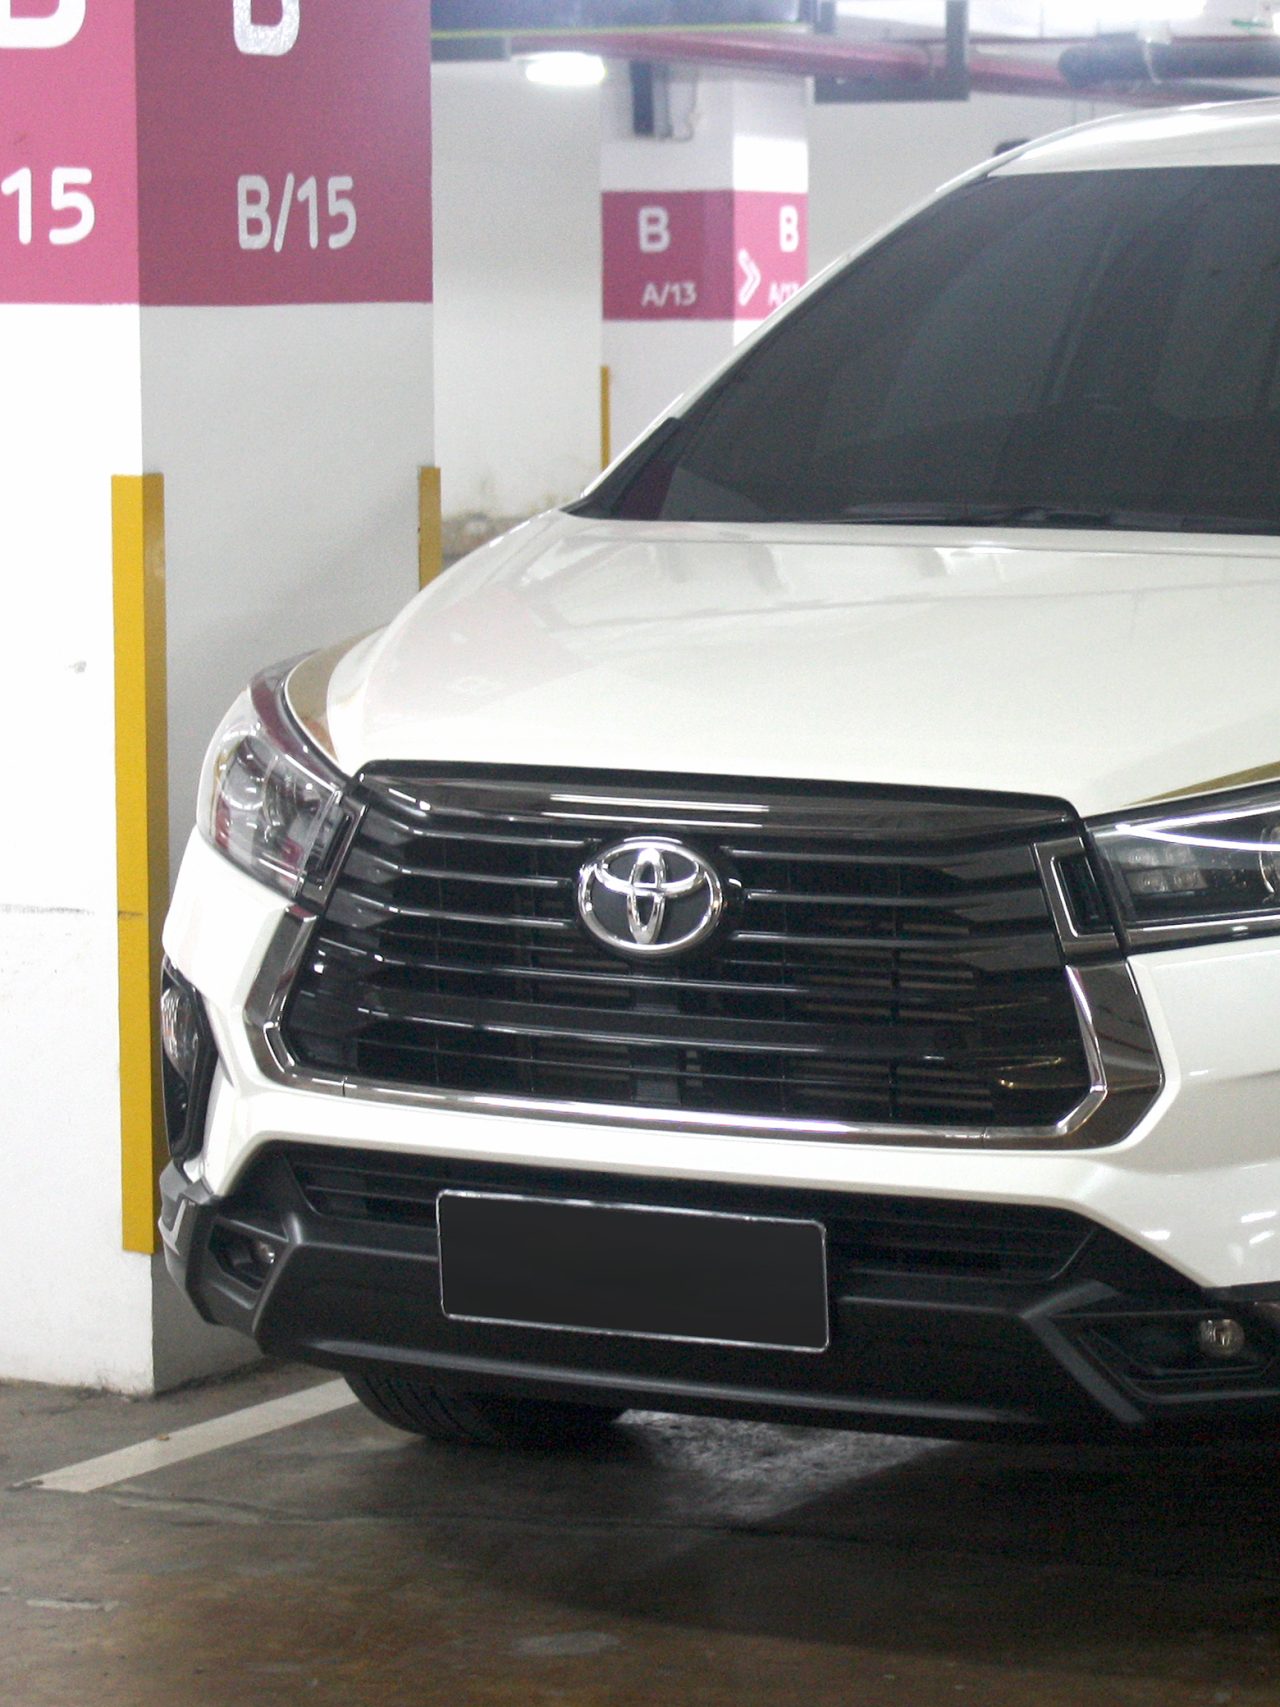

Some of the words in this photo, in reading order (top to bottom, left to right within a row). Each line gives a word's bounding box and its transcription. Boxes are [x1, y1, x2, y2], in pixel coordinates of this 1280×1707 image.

[0, 166, 96, 246] 15
[237, 172, 357, 253] B/15
[638, 205, 671, 253] B
[779, 205, 799, 252] B
[641, 280, 697, 307] A/13
